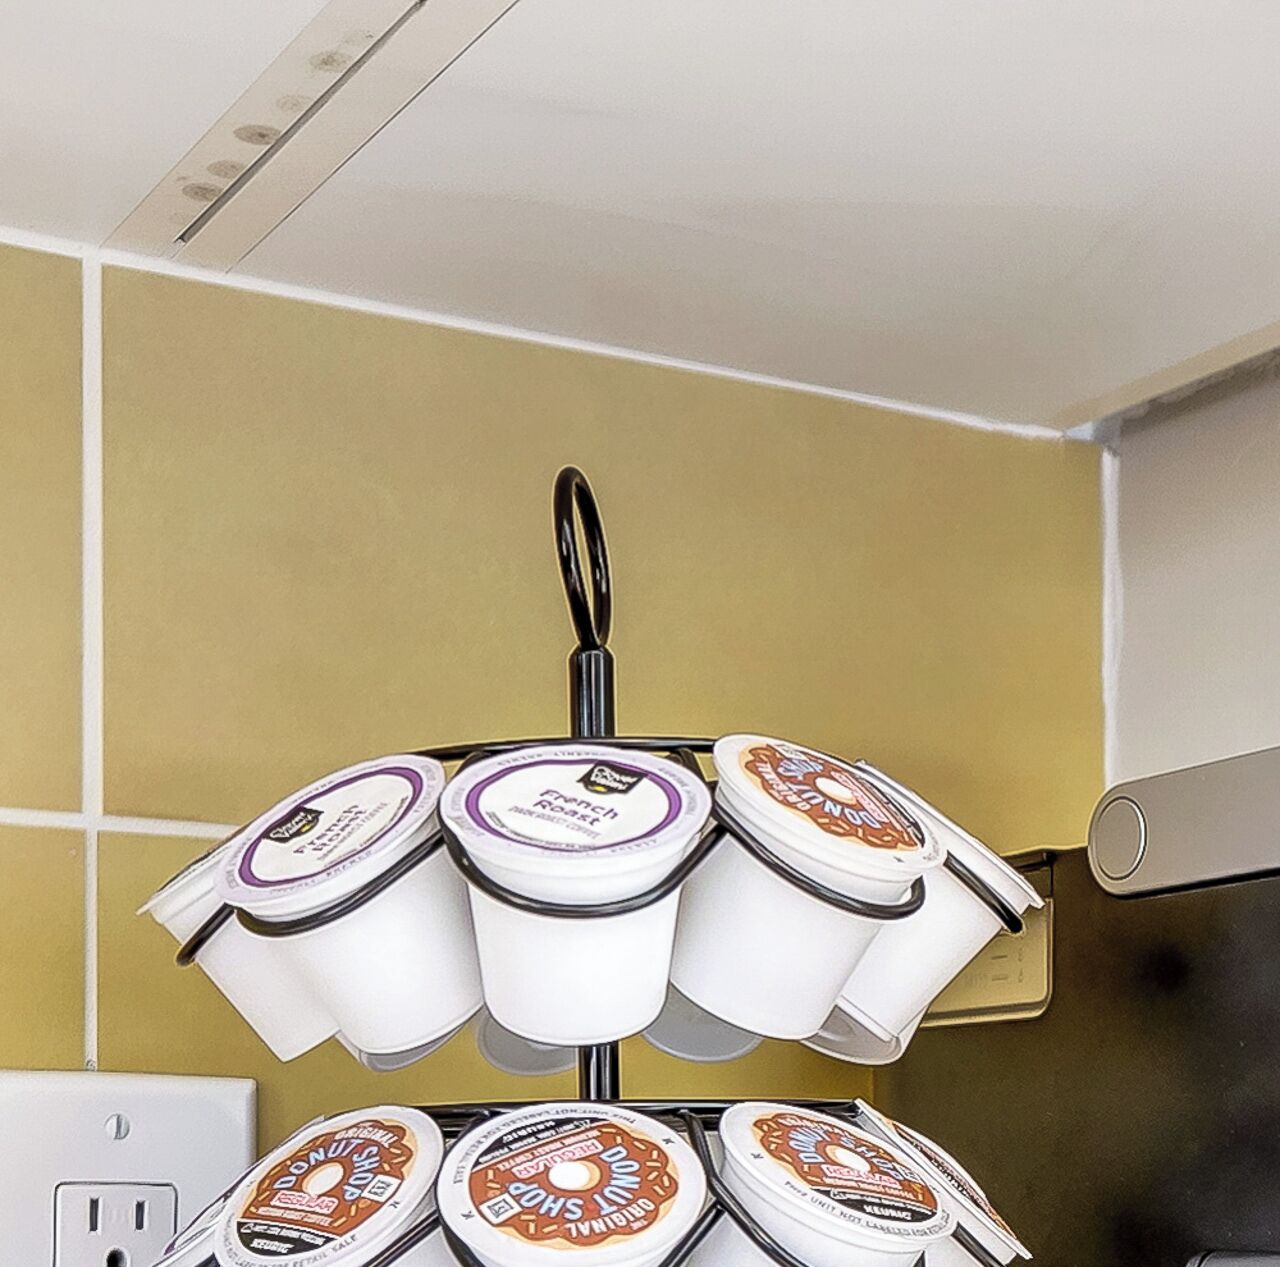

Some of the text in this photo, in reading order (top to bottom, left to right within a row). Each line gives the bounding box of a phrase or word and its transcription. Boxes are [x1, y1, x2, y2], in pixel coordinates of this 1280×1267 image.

[533, 799, 603, 827] Roast
[539, 788, 618, 821] French
[334, 1124, 399, 1148] ORIGINAL
[273, 1138, 383, 1202] DONUT SHOP
[511, 1140, 604, 1179] REGULAR
[507, 1144, 642, 1221] DONUT SHOP
[565, 1197, 657, 1239] ORIGINAL
